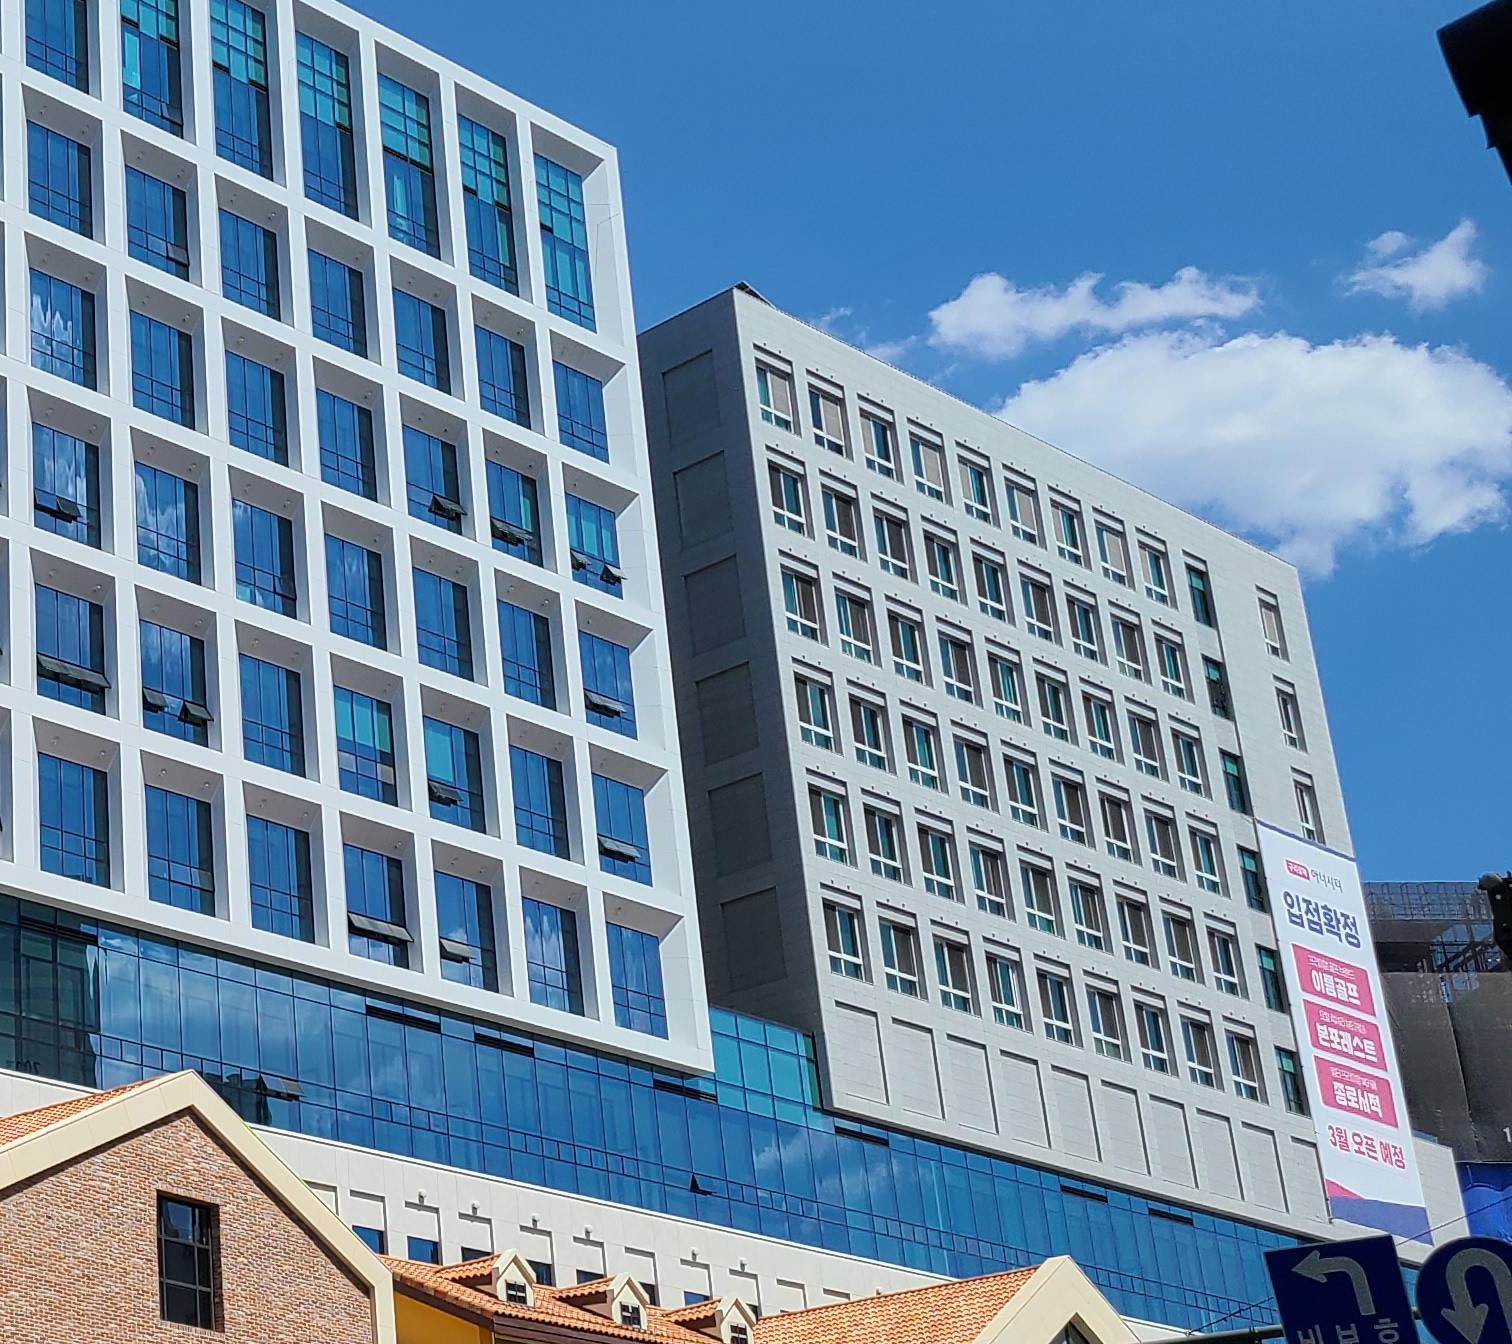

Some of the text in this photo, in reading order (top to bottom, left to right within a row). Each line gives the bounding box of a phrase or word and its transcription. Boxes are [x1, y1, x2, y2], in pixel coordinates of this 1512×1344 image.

[1283, 890, 1361, 949] 입점확정
[1327, 1124, 1407, 1170] 3월 오픈 예정
